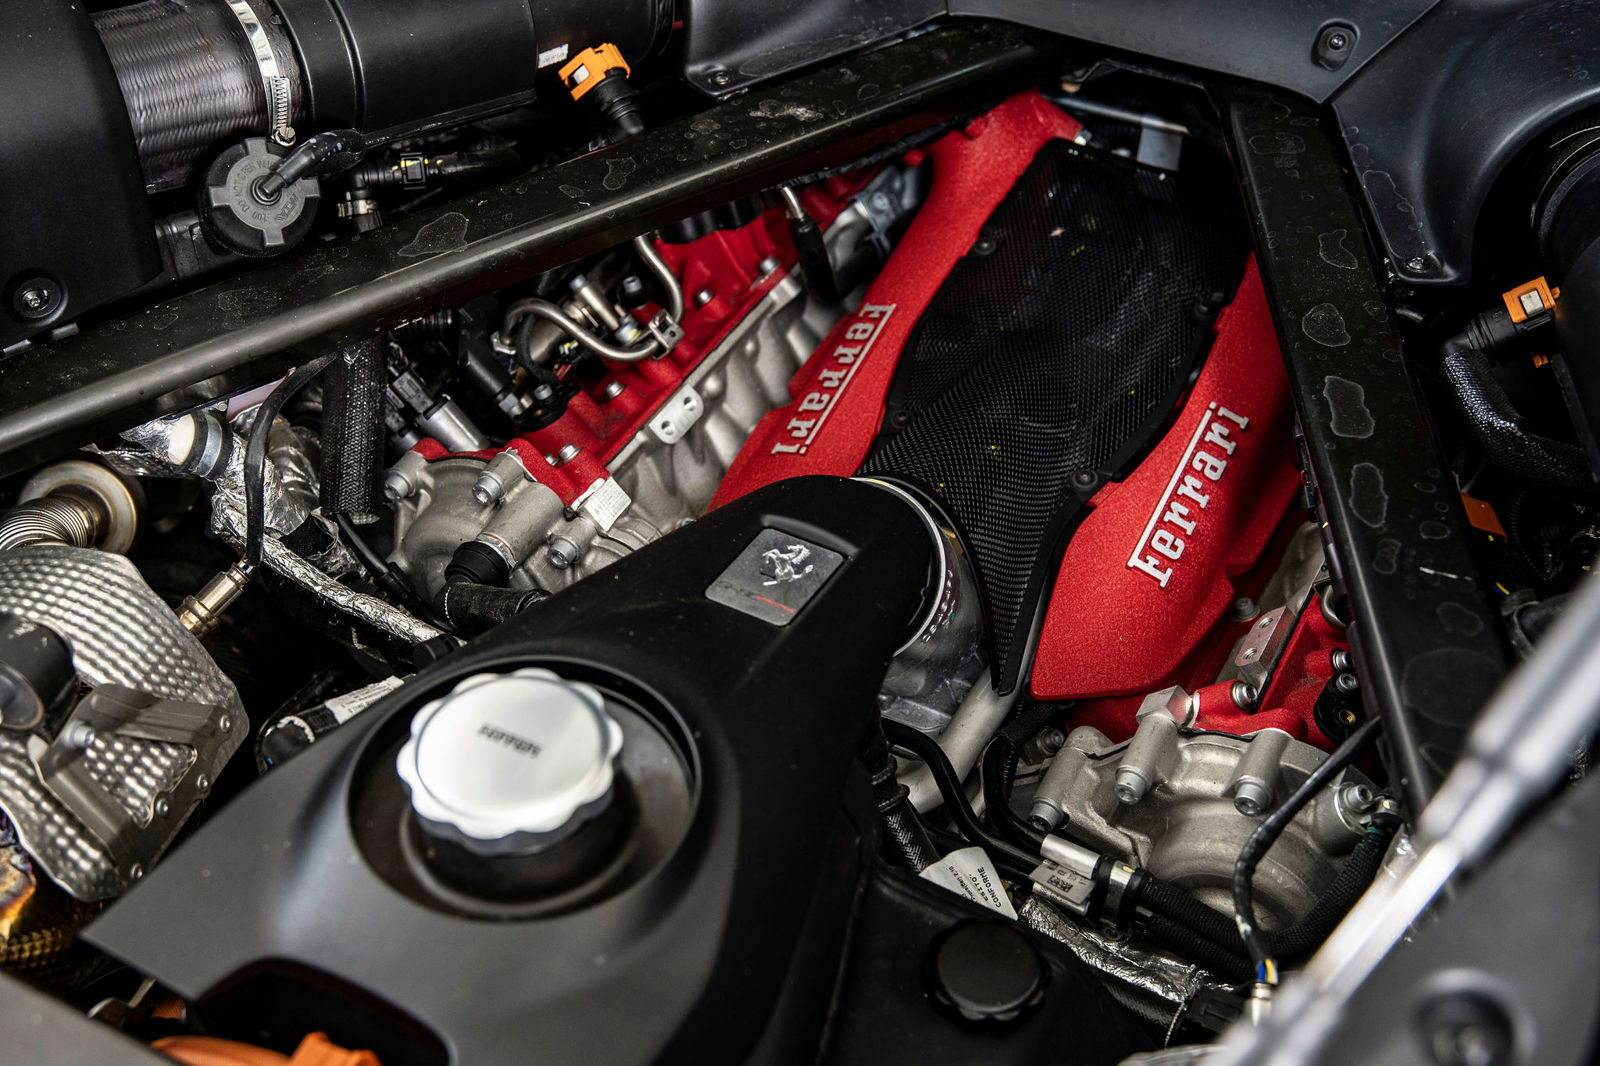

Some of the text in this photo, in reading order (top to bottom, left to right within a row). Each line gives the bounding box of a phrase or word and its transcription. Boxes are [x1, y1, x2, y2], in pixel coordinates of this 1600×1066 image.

[771, 302, 897, 455] Ferrari
[1127, 401, 1249, 588] Ferrari
[977, 866, 1002, 908] CONFORME
